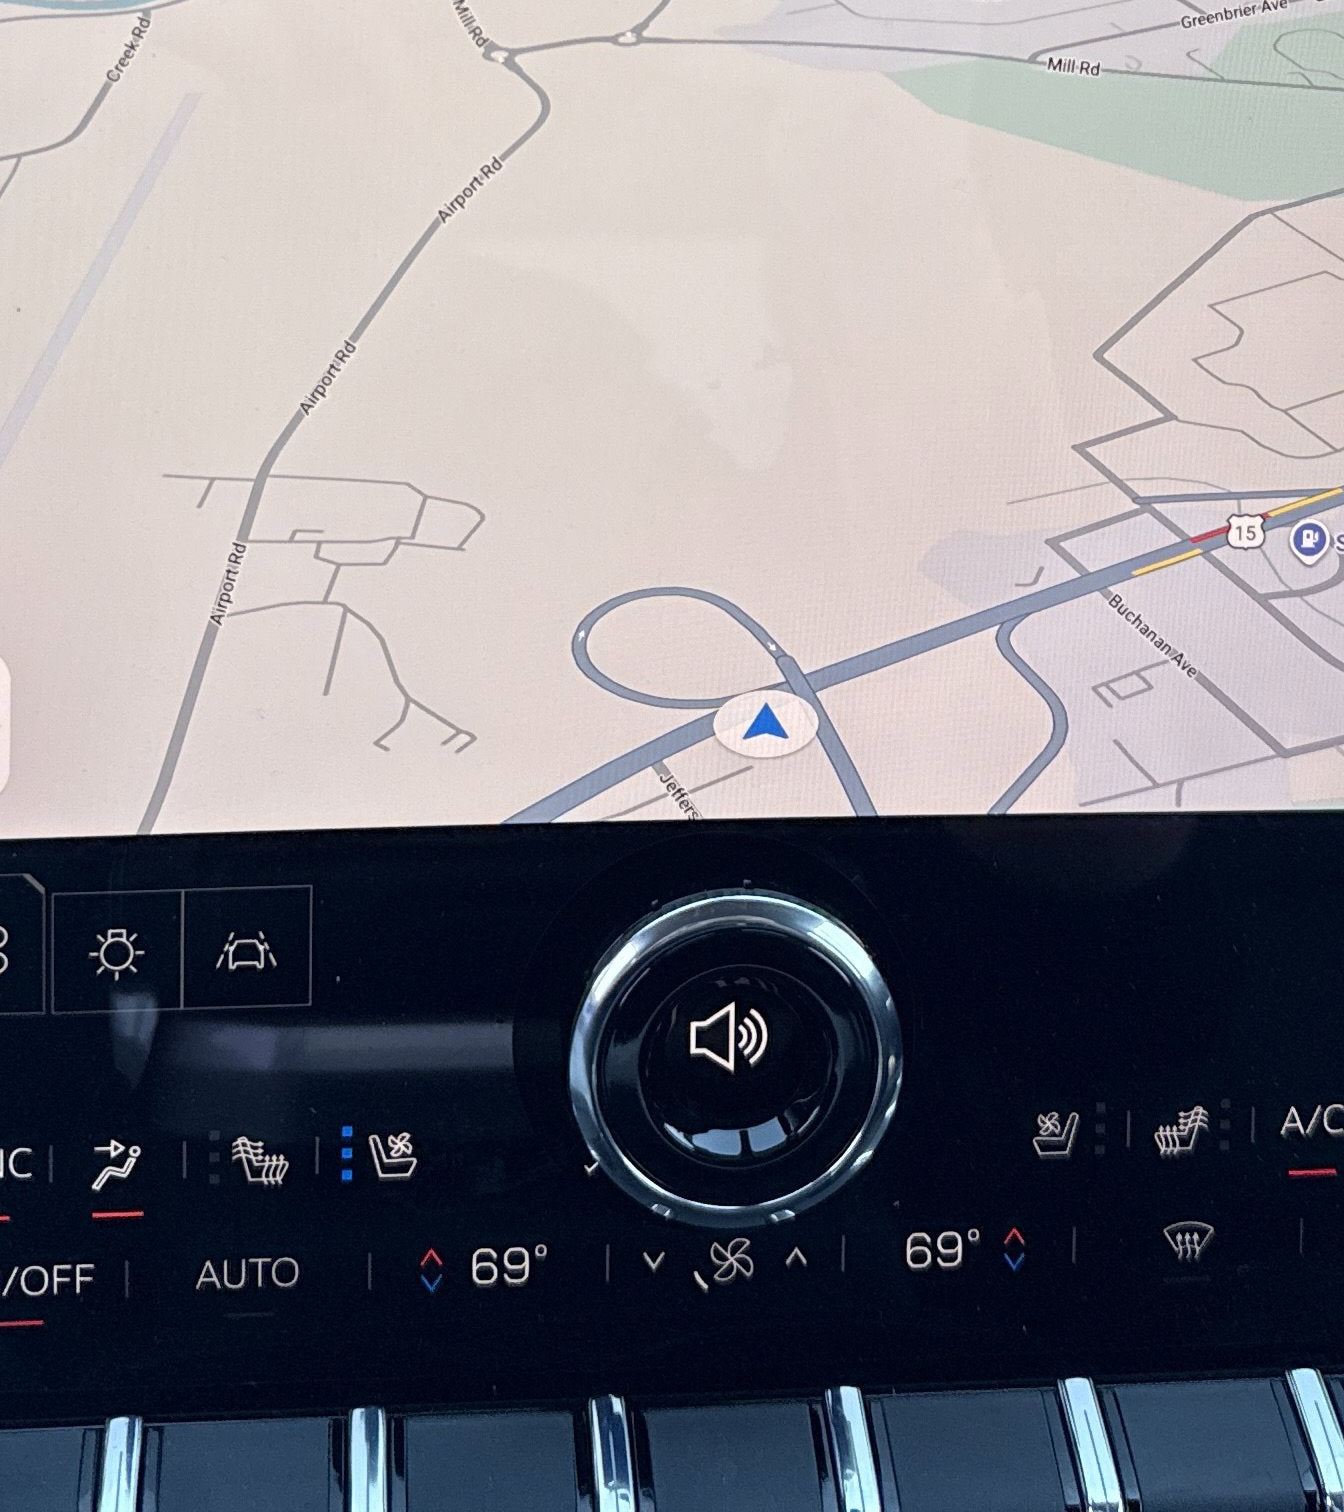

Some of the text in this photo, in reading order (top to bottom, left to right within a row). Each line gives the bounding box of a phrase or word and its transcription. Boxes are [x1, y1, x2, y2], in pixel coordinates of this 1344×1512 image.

[469, 25, 487, 49] Rd
[1181, 3, 1260, 29] Greenbrier
[106, 16, 151, 84] Creek Rd
[1047, 57, 1100, 76] Mill Rd
[438, 157, 503, 224] Airport Rd
[299, 340, 356, 416] Airport Rd
[1235, 525, 1256, 541] 15
[211, 541, 247, 626] Airport Rd
[1108, 594, 1198, 678] Buchanan Ave
[471, 1244, 548, 1286] 69°
[905, 1229, 981, 1271] 69°
[196, 1257, 300, 1289] AUTO
